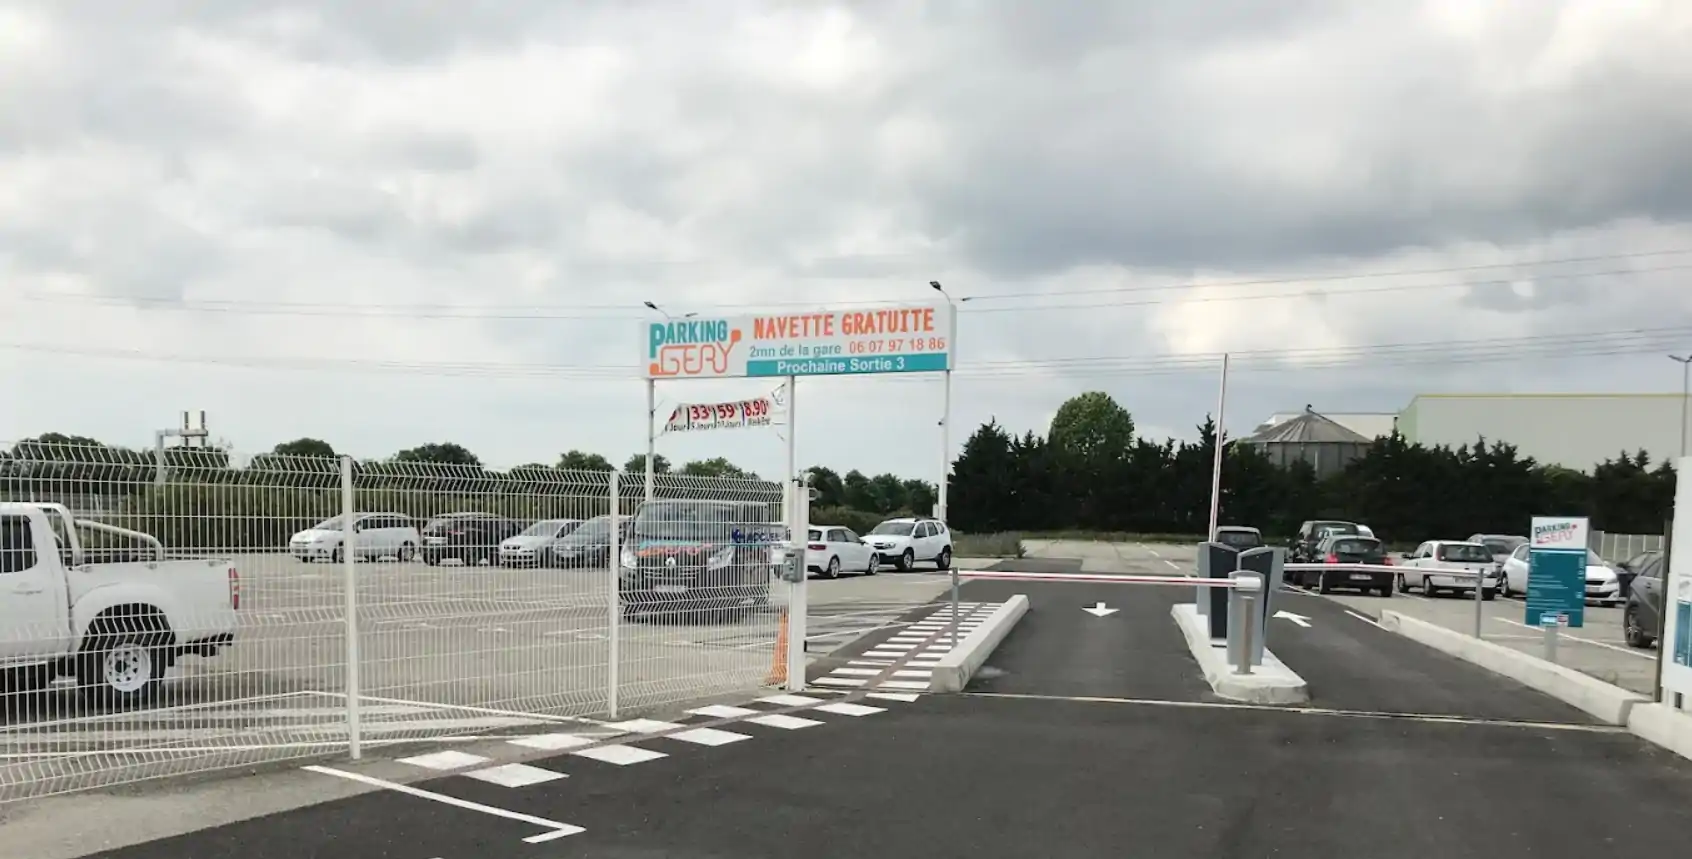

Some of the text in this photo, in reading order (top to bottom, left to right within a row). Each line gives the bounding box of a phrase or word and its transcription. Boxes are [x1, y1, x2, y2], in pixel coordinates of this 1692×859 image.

[650, 320, 728, 358] PARKING
[754, 308, 935, 339] NAVETTE GRATUITE
[655, 331, 741, 375] GERY
[750, 337, 945, 358] 2mn de la gare 06 07 97 18 86
[777, 356, 905, 374] Prochaine Sortie 3
